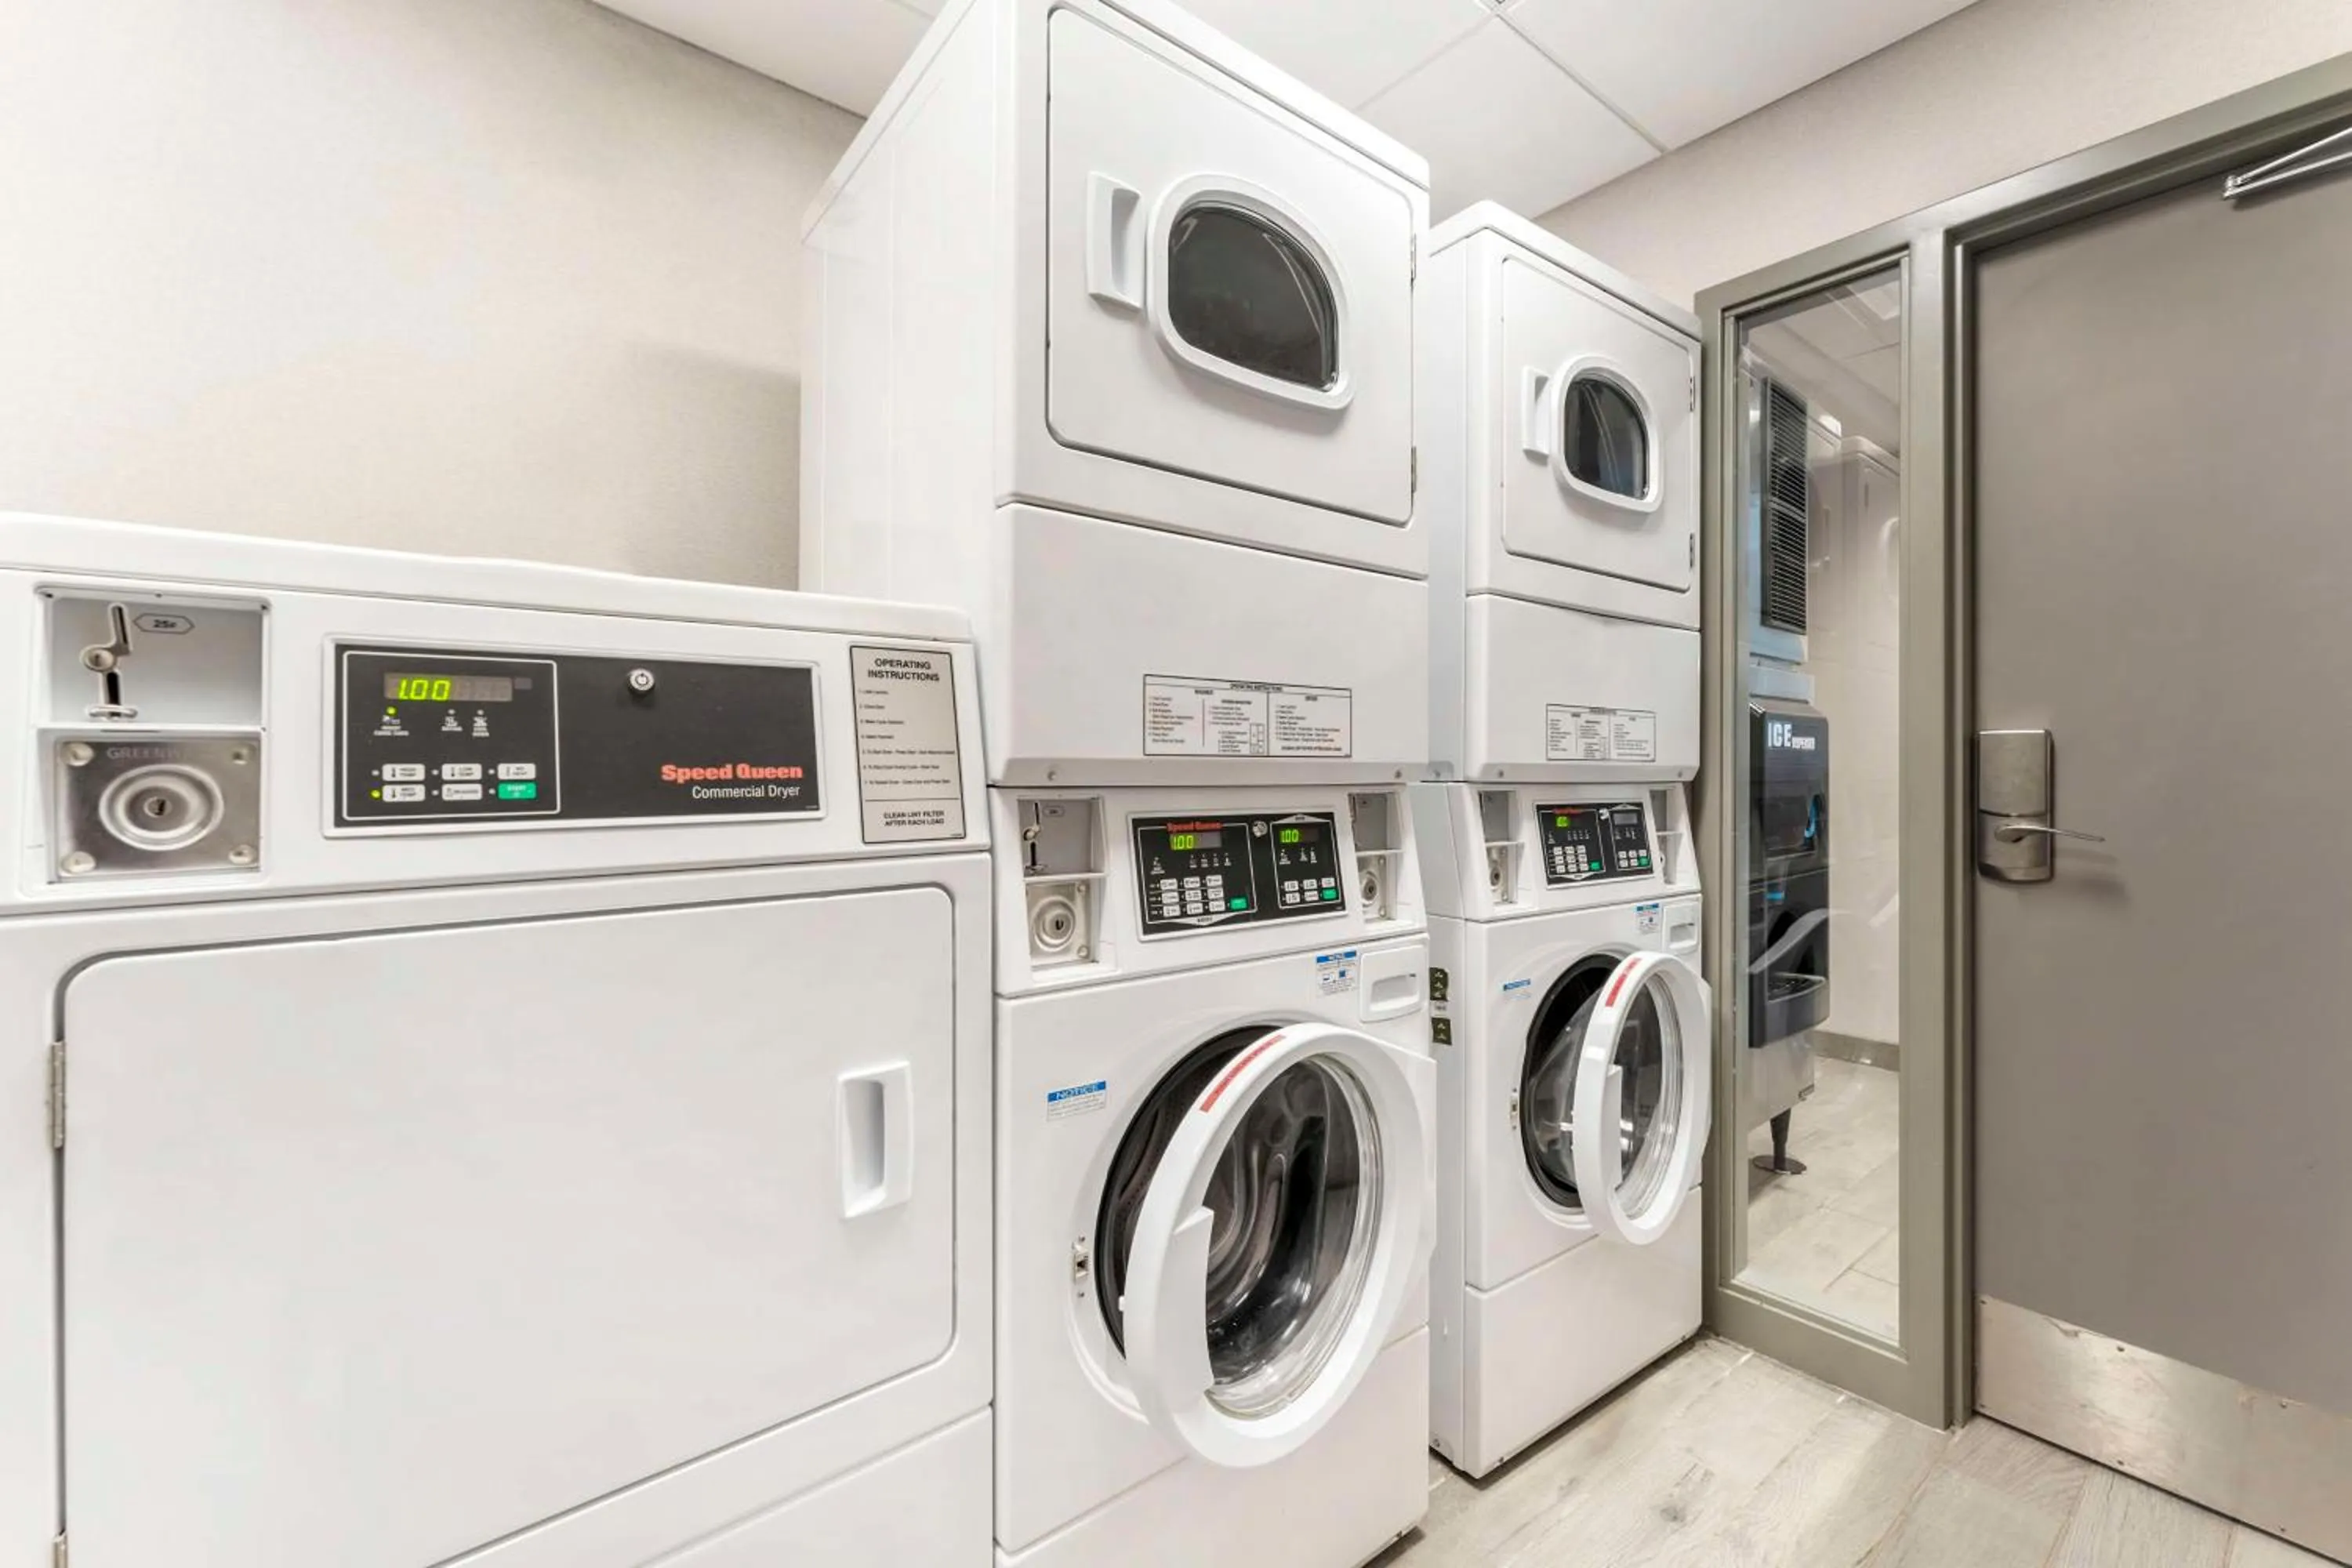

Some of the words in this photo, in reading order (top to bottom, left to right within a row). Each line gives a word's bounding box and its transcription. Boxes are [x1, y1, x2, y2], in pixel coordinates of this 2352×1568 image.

[874, 658, 931, 670] OPERATING
[867, 669, 940, 681] INSTRUCTIONS
[1767, 722, 1792, 747] ICE
[661, 764, 733, 783] Speed
[736, 763, 804, 780] Queen
[691, 786, 765, 799] Commercial
[768, 785, 800, 799] Dryer
